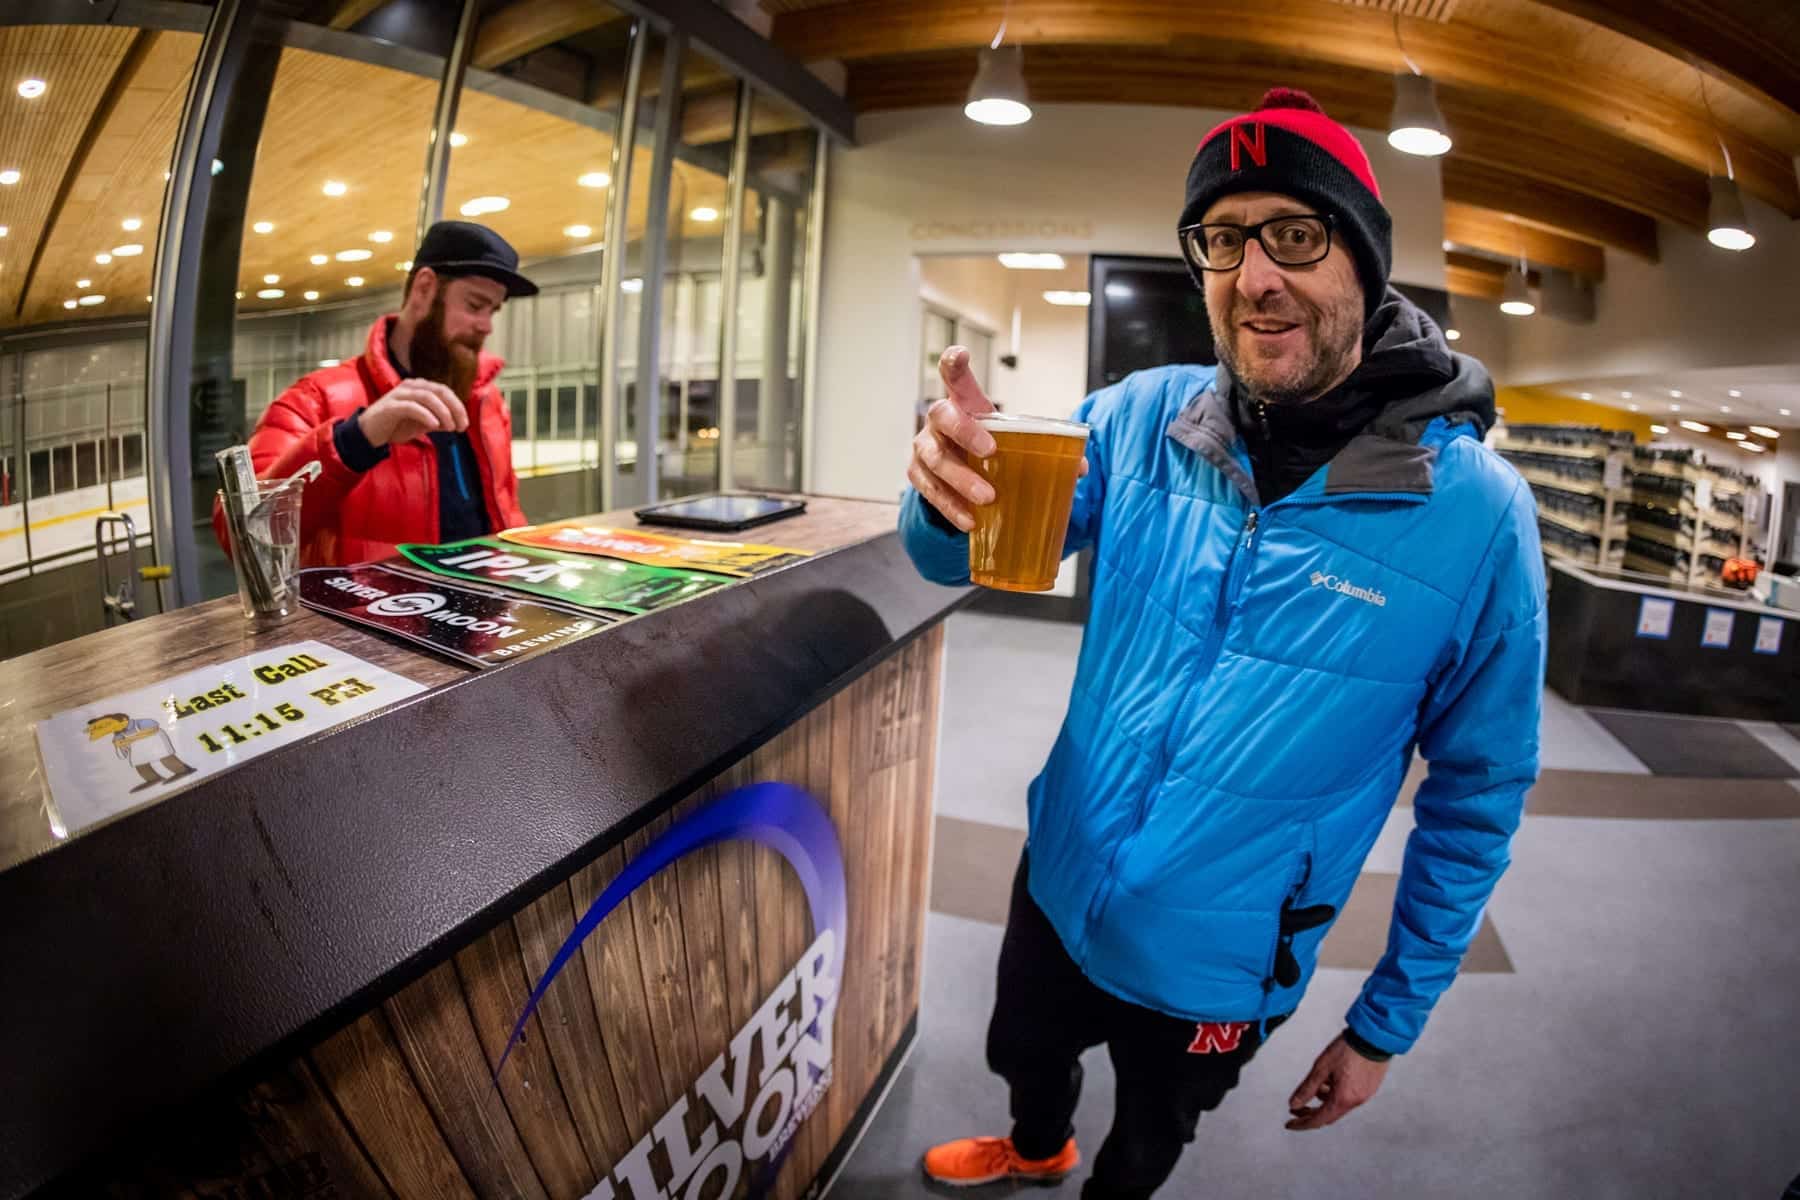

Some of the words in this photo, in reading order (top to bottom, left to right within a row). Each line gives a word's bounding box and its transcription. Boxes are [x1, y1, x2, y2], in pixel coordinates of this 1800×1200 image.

[1230, 122, 1267, 172] N
[437, 550, 566, 583] IPA
[323, 576, 389, 600] SILVER
[423, 609, 527, 639] MOON
[1322, 574, 1386, 607] Columbia
[493, 619, 590, 657] BREWING
[162, 682, 247, 719] Last
[253, 653, 329, 686] Call
[197, 701, 305, 753] 11:15
[309, 676, 376, 707] PM
[1186, 1022, 1251, 1054] N
